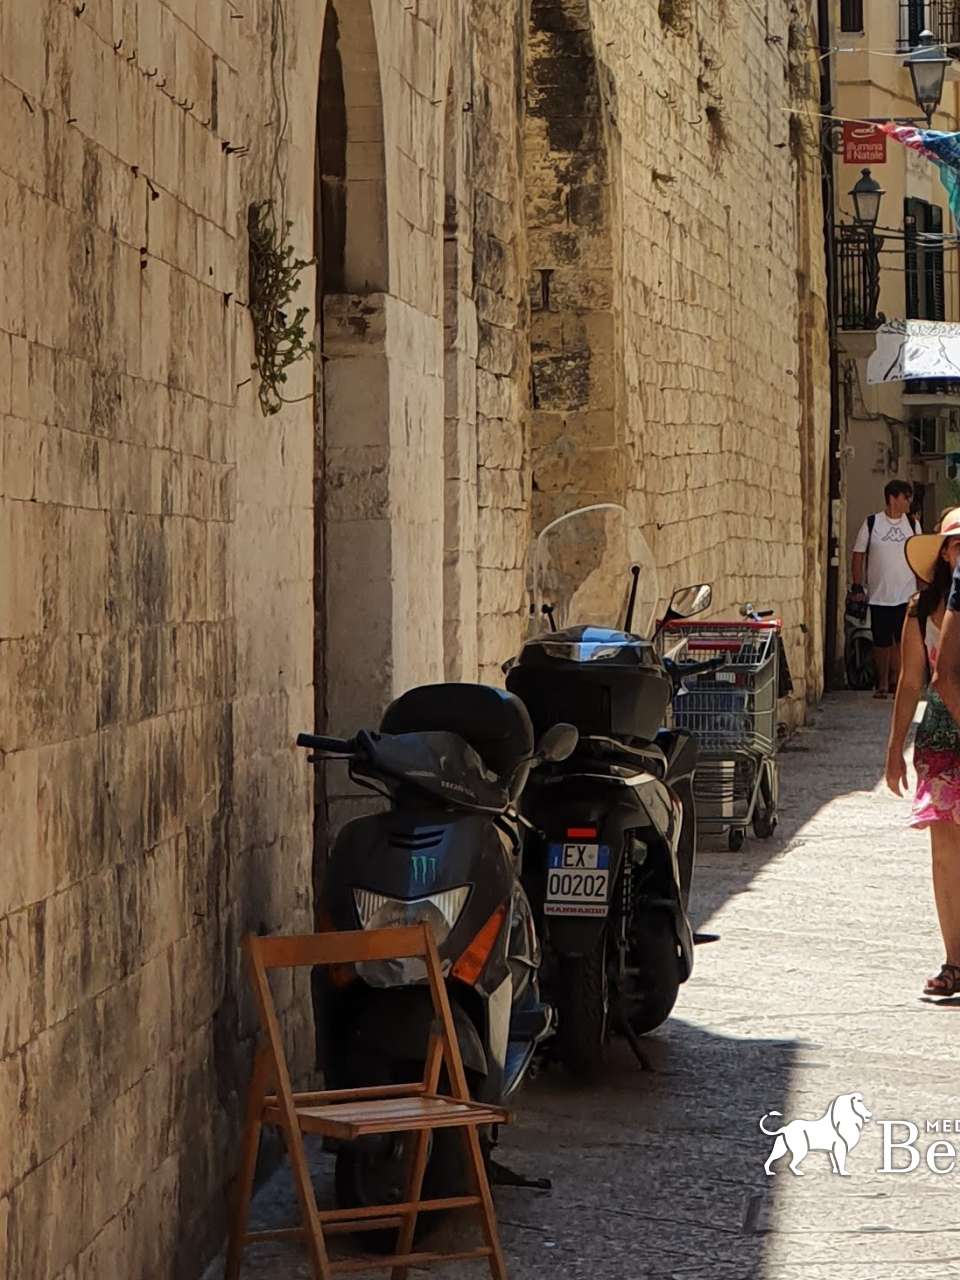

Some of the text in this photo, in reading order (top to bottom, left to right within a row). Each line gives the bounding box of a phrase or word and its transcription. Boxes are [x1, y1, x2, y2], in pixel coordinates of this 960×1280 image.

[853, 150, 884, 160] Natale
[564, 846, 587, 867] EX
[549, 873, 606, 897] 00202
